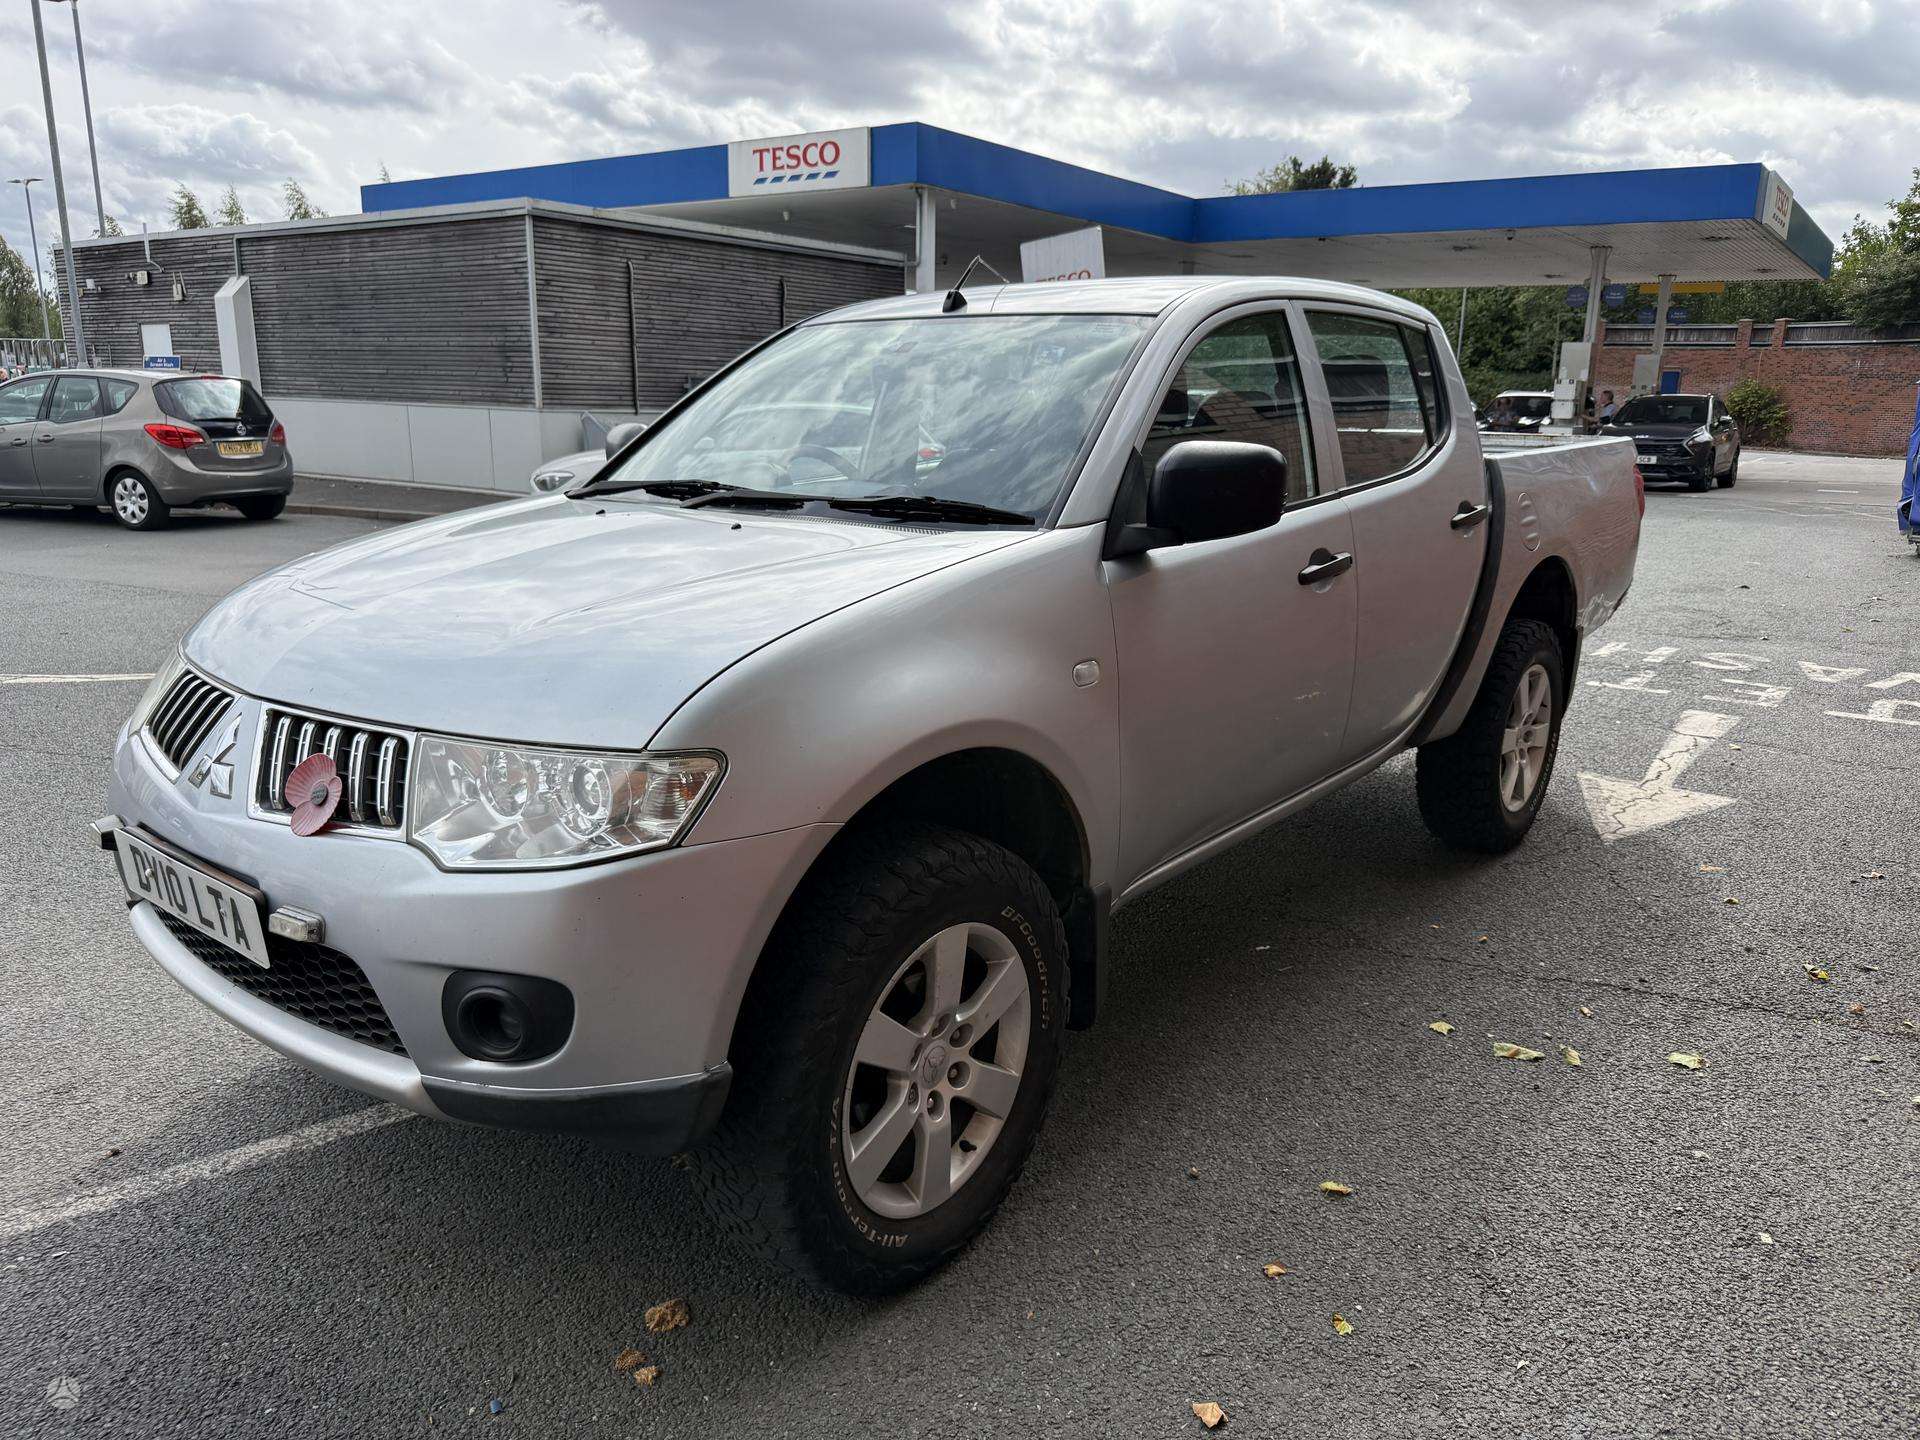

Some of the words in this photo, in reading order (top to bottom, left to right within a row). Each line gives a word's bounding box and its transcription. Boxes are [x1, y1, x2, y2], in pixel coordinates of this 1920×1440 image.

[752, 141, 841, 172] TESCO
[129, 844, 188, 914] DY10
[189, 876, 252, 952] LTA
